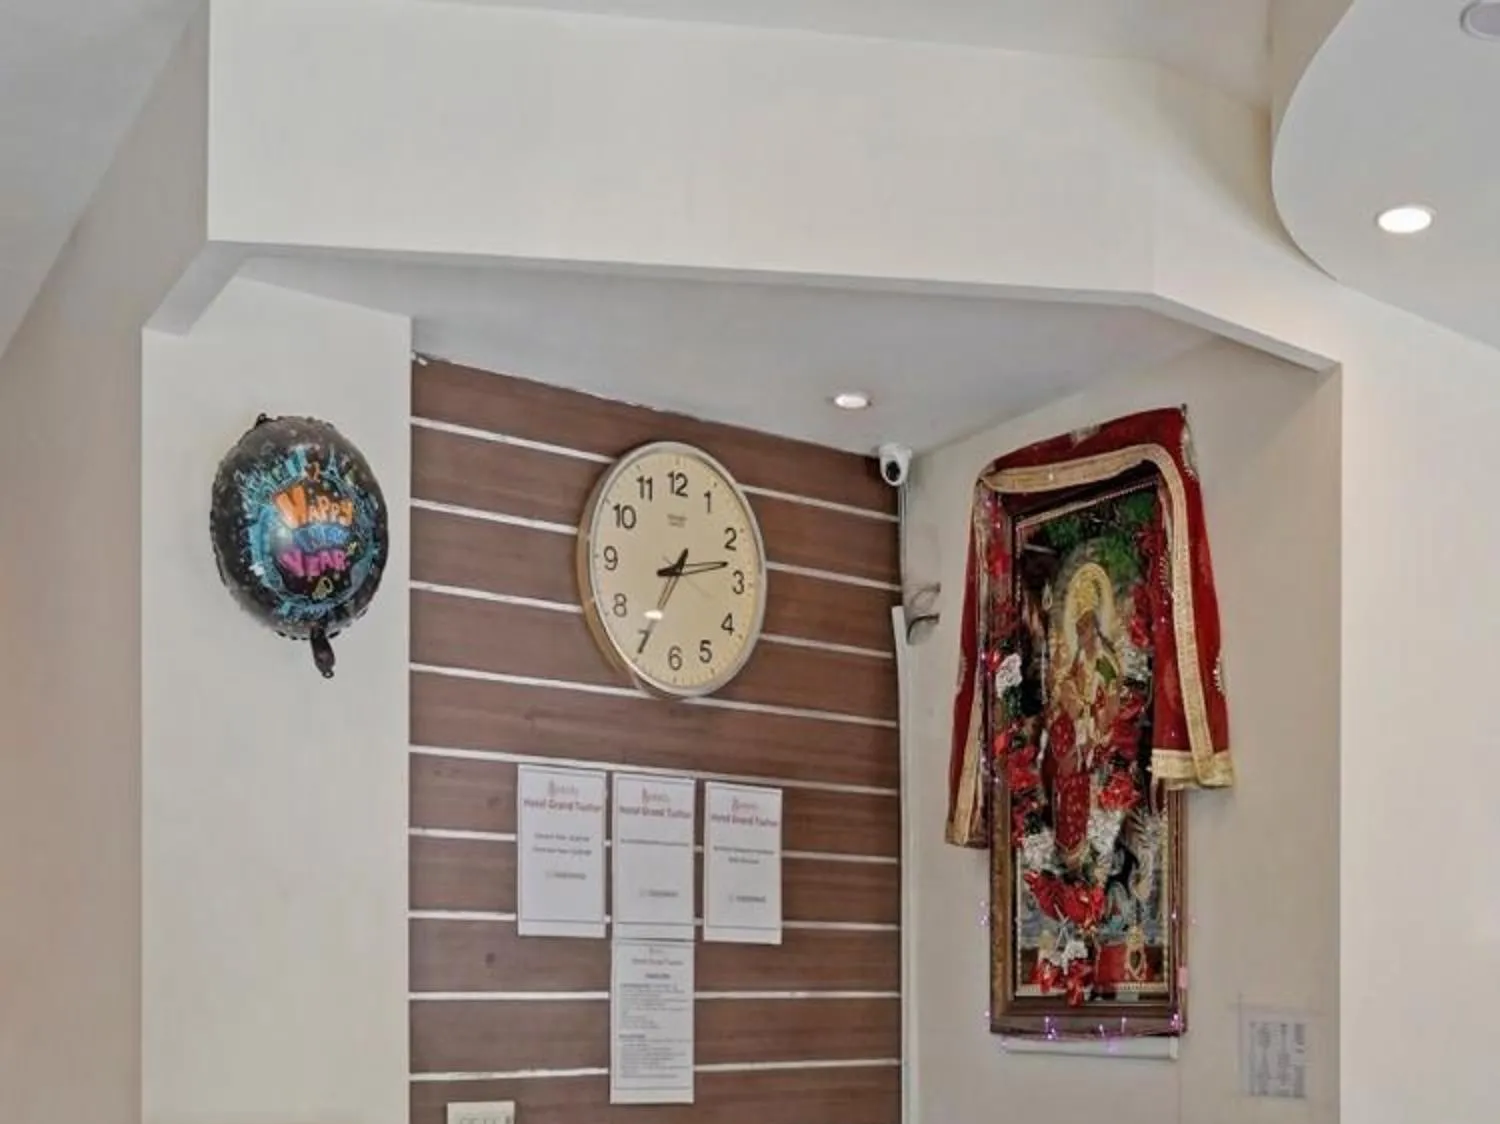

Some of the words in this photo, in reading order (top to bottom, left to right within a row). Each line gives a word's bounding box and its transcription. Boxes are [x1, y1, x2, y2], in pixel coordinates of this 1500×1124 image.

[636, 475, 653, 502] 11
[667, 471, 689, 498] 12
[703, 490, 713, 514] 1
[612, 503, 637, 529] 10
[723, 527, 738, 551] 2
[603, 545, 618, 571] 9
[732, 570, 746, 595] 3
[612, 592, 627, 618] 8
[720, 612, 735, 636] 4
[636, 628, 651, 654] 7
[699, 639, 713, 664] 5
[667, 645, 683, 671] 6
